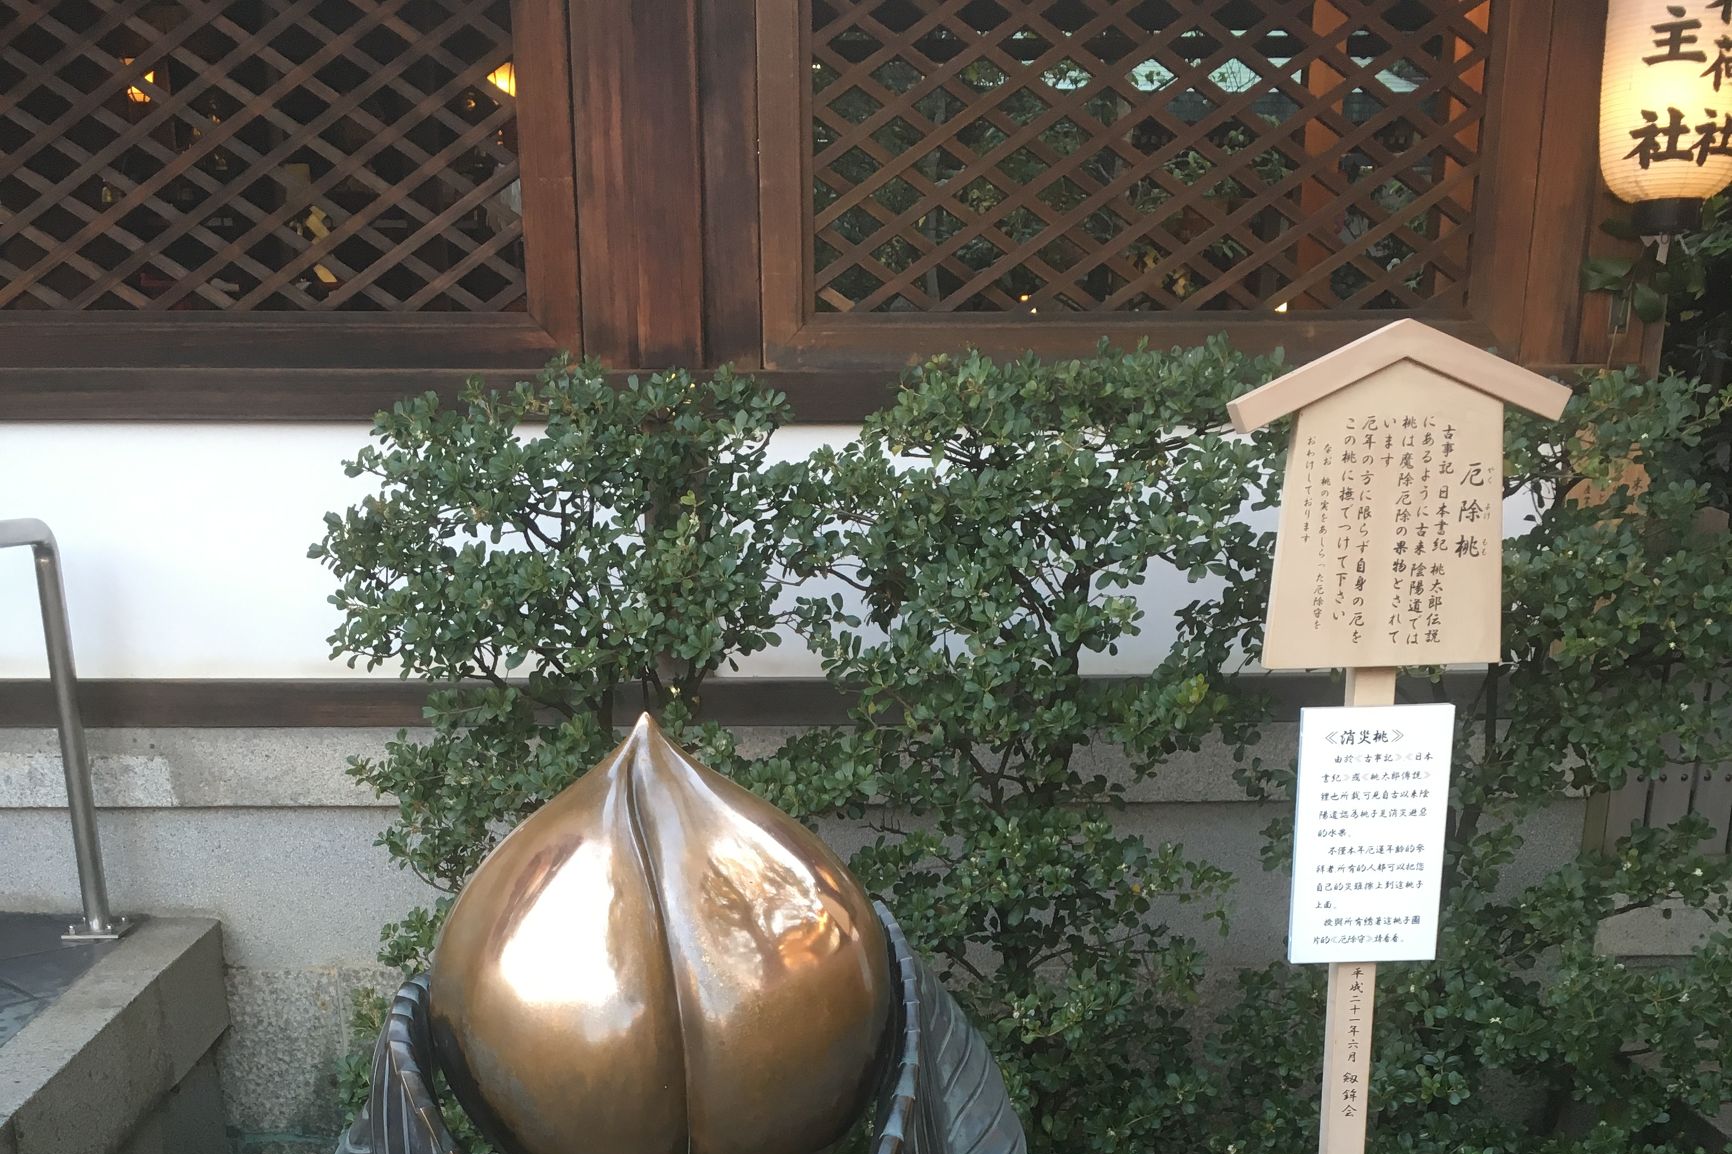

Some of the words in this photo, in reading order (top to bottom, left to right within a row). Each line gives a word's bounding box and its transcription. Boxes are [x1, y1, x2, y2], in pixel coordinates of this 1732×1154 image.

[1380, 417, 1397, 468] います
[1438, 424, 1456, 475] 古事記
[1332, 417, 1357, 621] この桃に撫でつけて下さい
[1349, 415, 1378, 644] 厄年の方に限らず自身の厄を
[1431, 485, 1450, 552] 日本書紀
[1454, 462, 1484, 558] 厄除桃
[1424, 563, 1446, 644] 桃太郎伝説
[1347, 967, 1364, 1063] 平成二十一年六月
